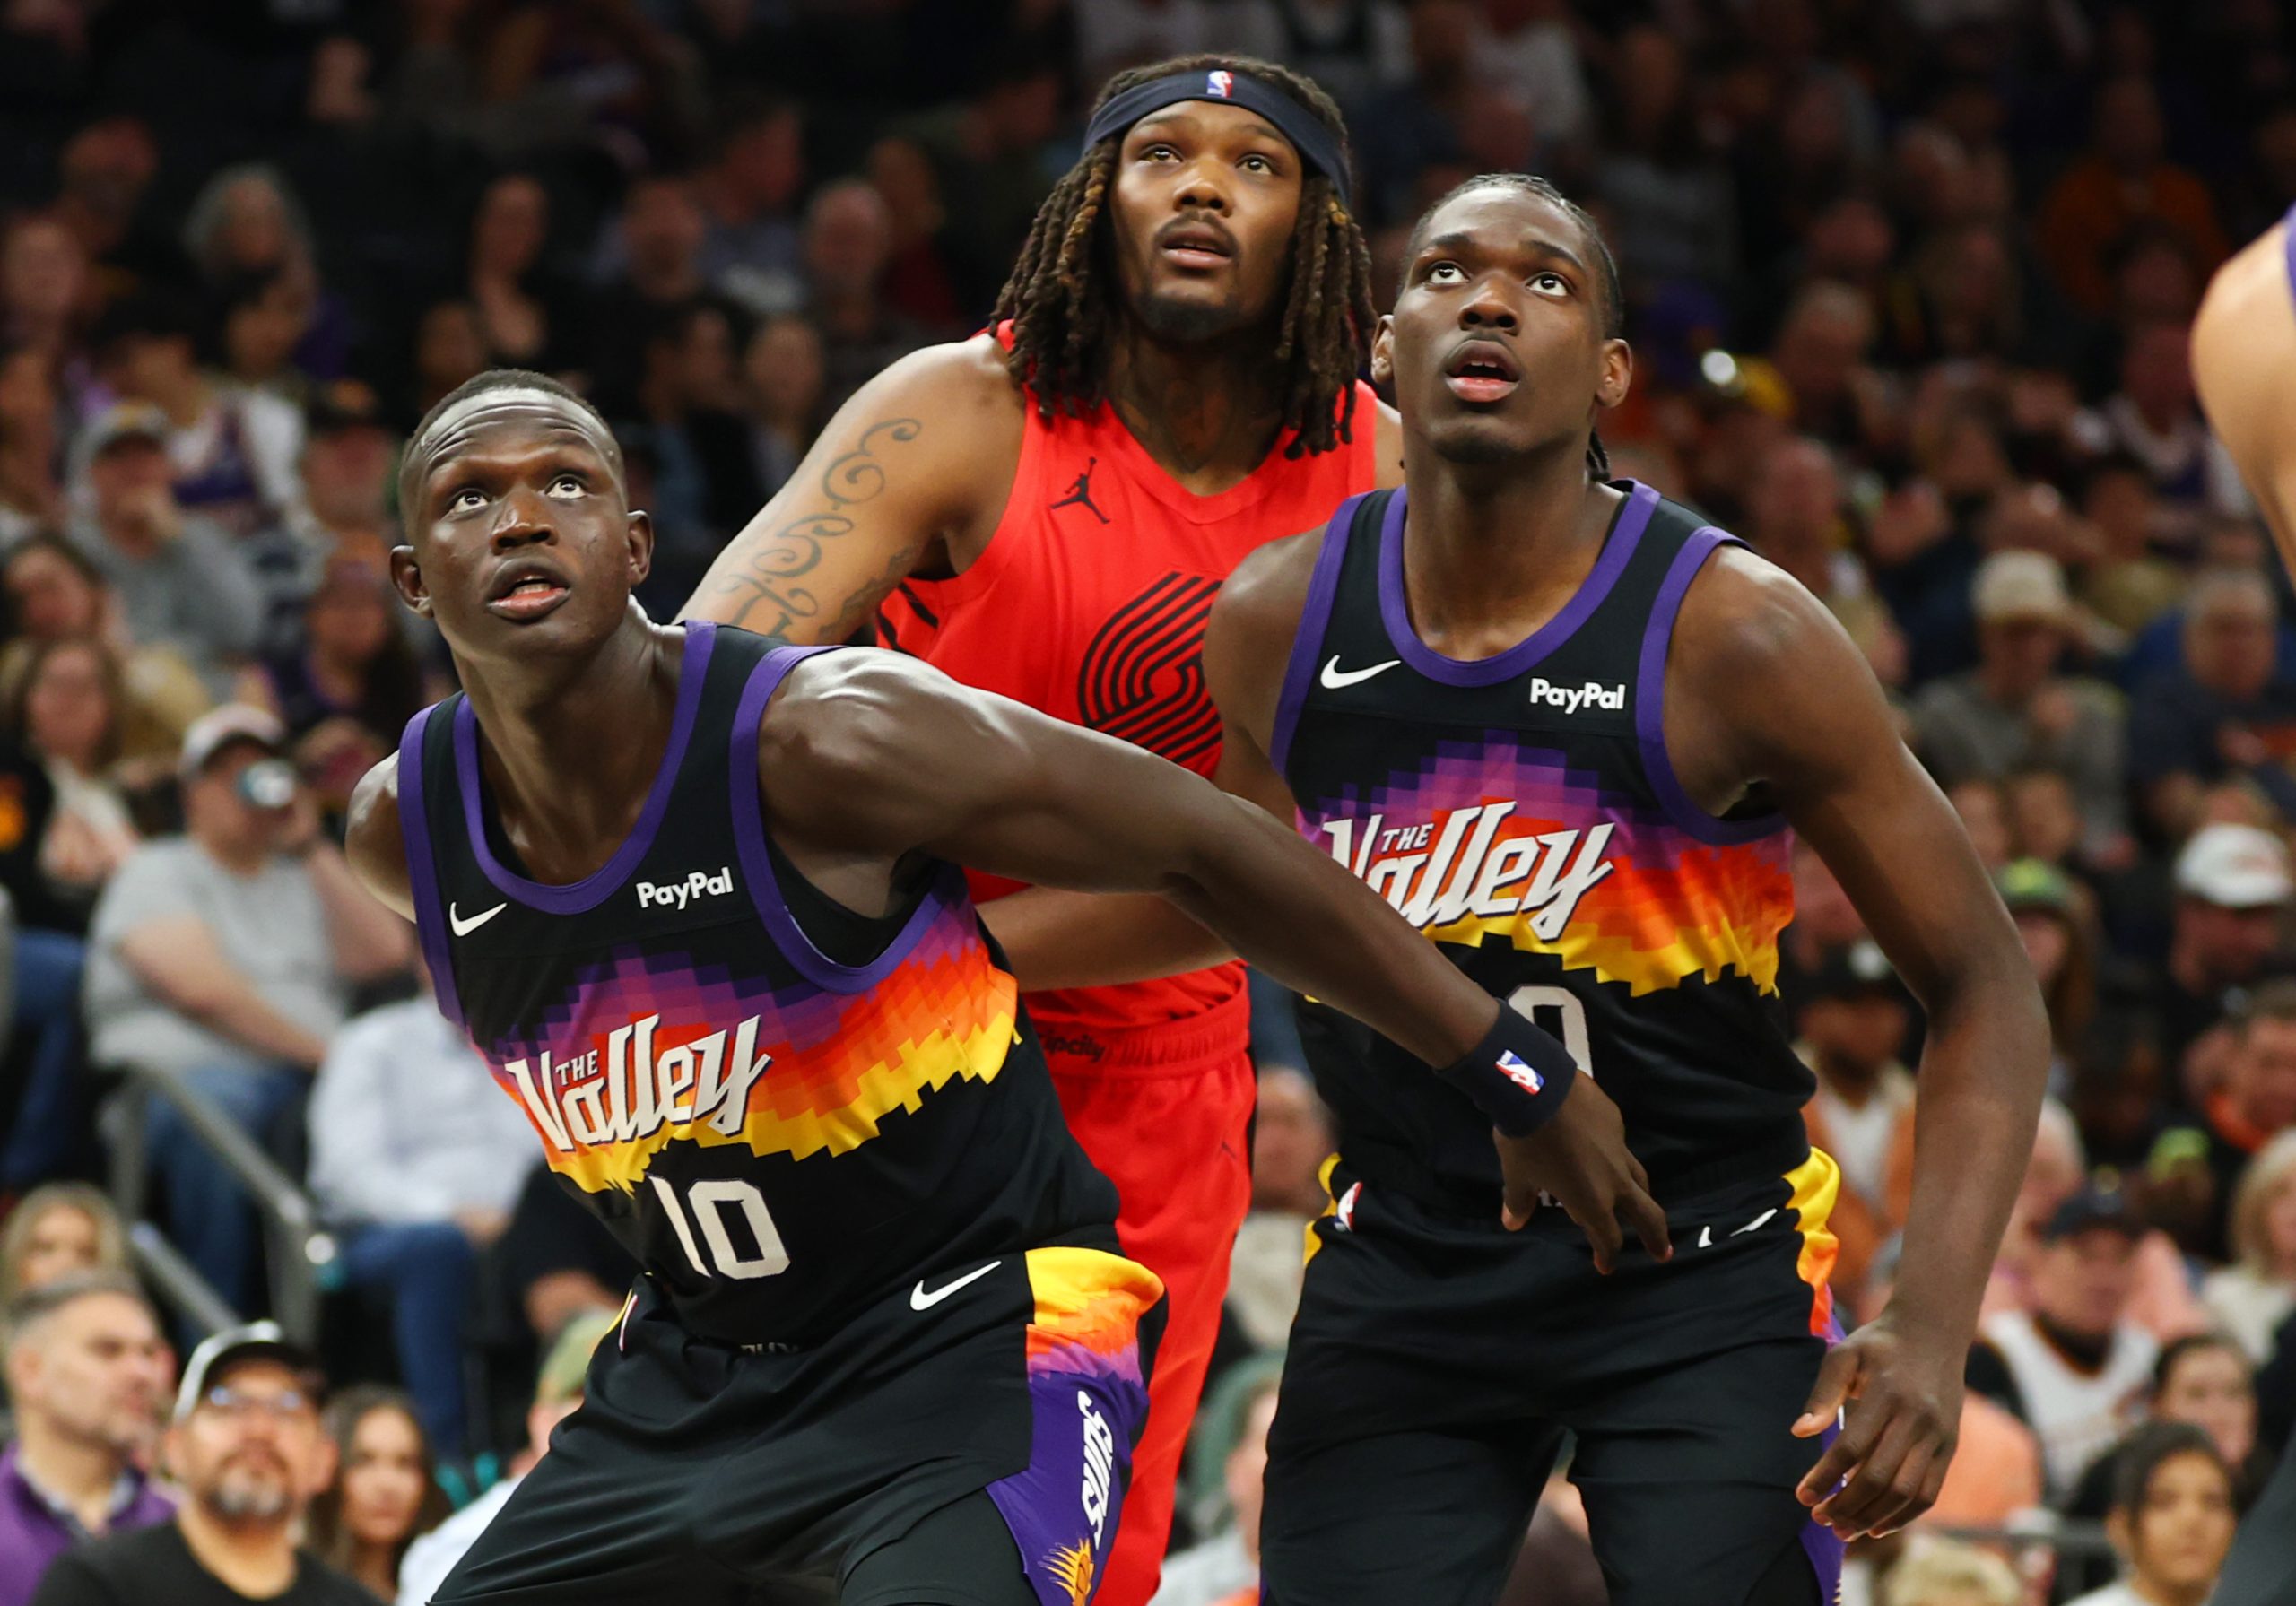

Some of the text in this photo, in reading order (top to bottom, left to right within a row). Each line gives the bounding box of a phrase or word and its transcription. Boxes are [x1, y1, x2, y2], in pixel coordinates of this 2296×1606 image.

[1529, 678, 1626, 715] PayPal
[1381, 822, 1435, 853] THE
[636, 866, 734, 910] PayPal
[504, 1013, 774, 1152] Valley
[555, 1048, 599, 1087] THE
[648, 1172, 791, 1280] 10
